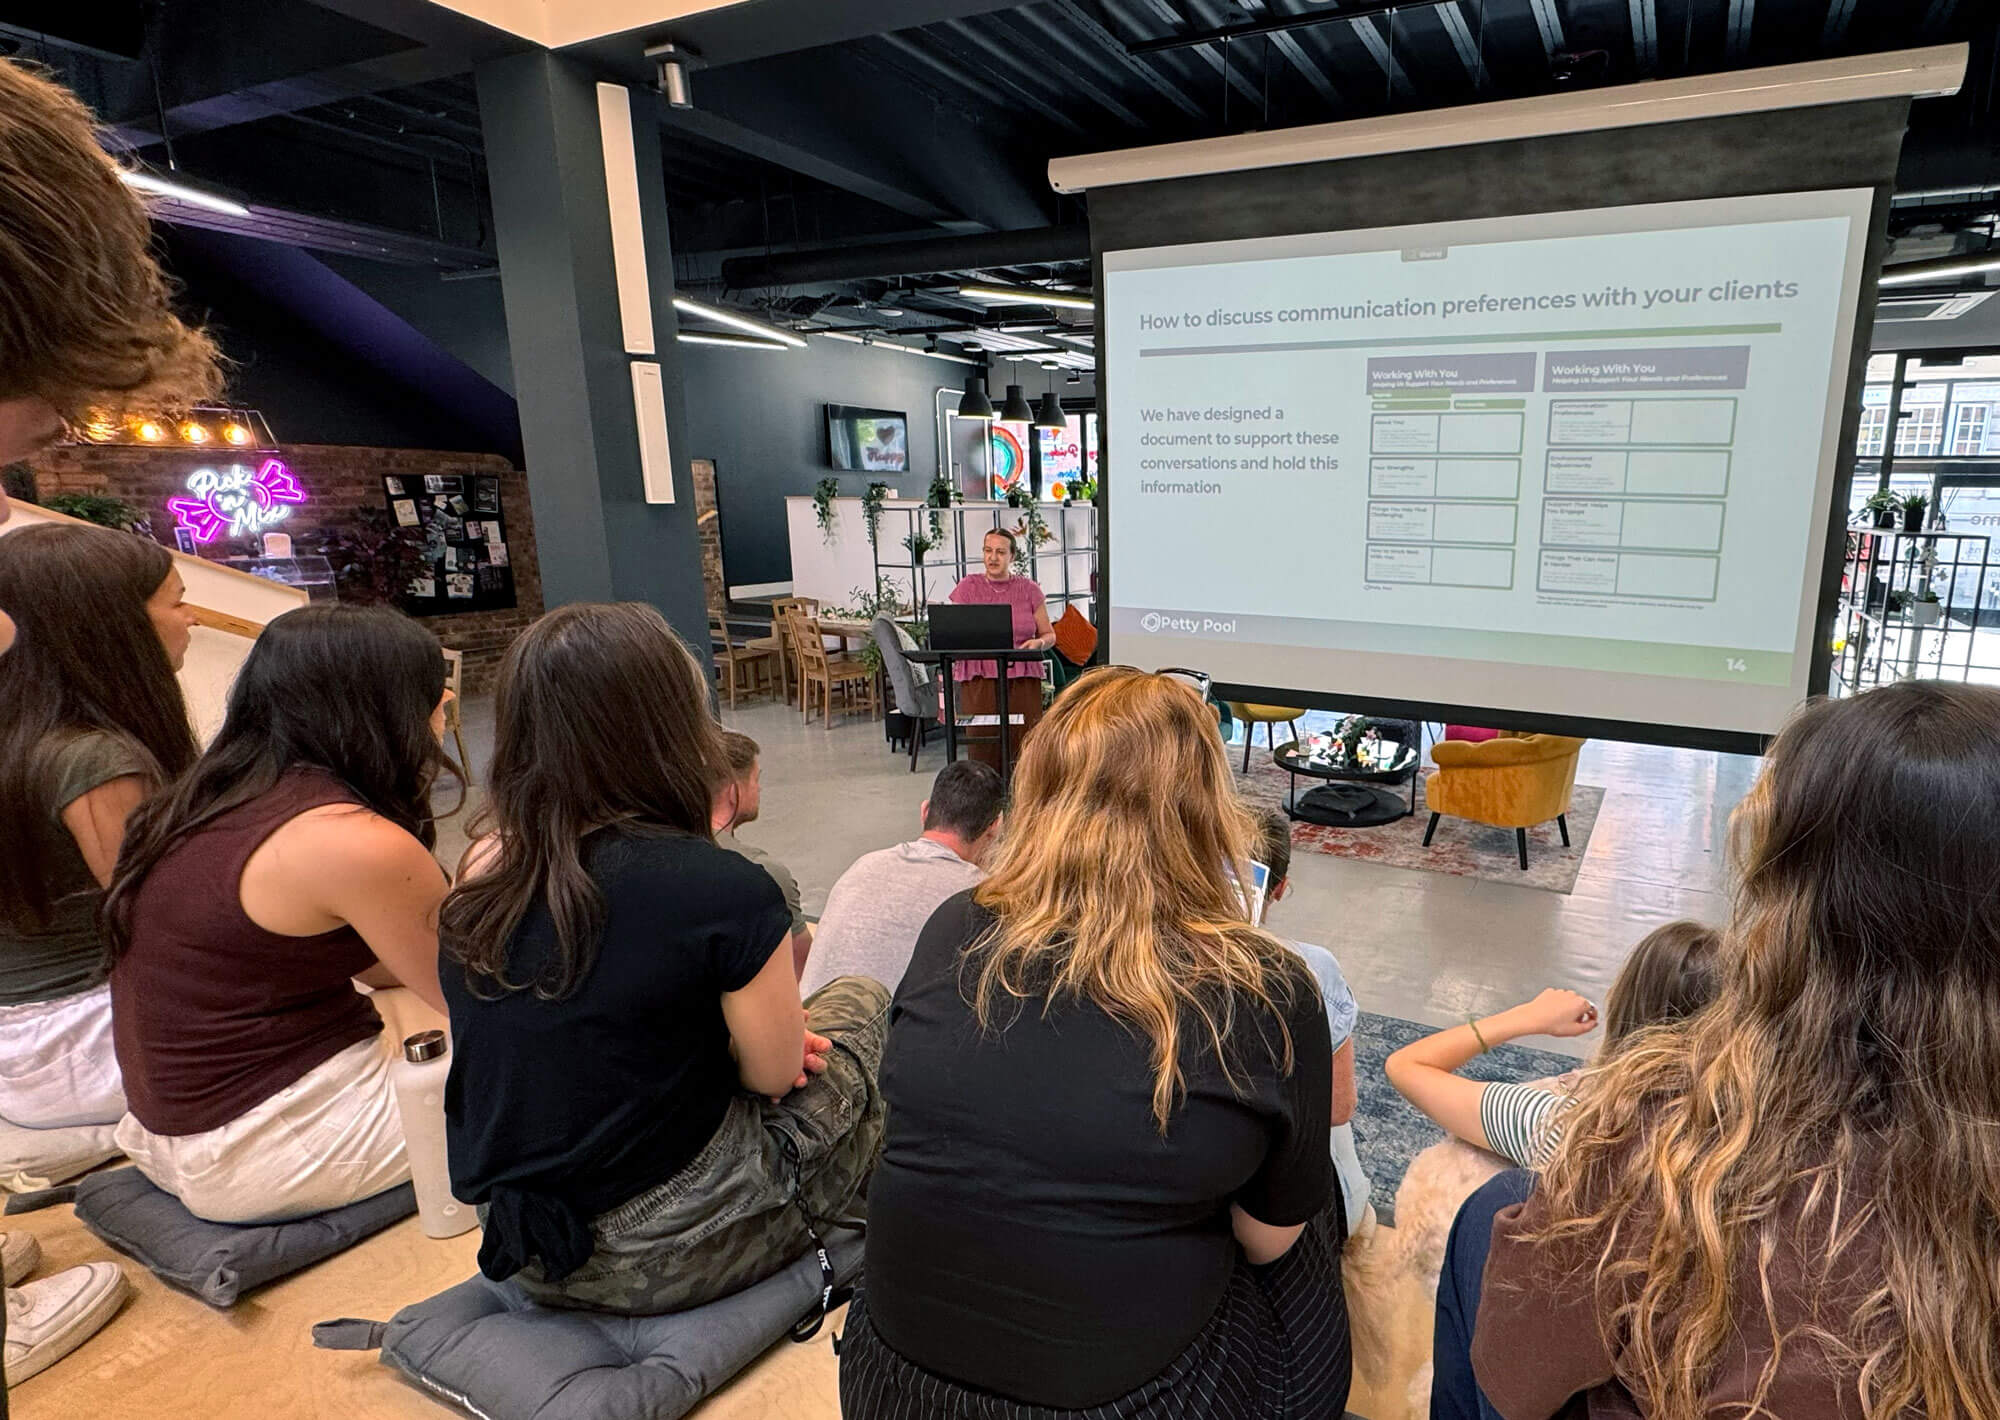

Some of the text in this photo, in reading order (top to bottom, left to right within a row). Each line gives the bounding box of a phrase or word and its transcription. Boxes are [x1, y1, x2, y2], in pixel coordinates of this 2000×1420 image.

[1140, 279, 1799, 331] How to discuss communication preferences with your clients
[1372, 368, 1458, 381] Working With You
[1552, 363, 1656, 376] Working With You
[1140, 406, 1284, 423] We have designed a
[1140, 431, 1339, 448] document to support these
[1140, 455, 1339, 471] conversations and hold this
[187, 464, 253, 500] Pick
[1140, 479, 1222, 494] information
[229, 500, 290, 537] Mix
[1161, 616, 1236, 633] Petty Pool
[1726, 658, 1747, 671] 14
